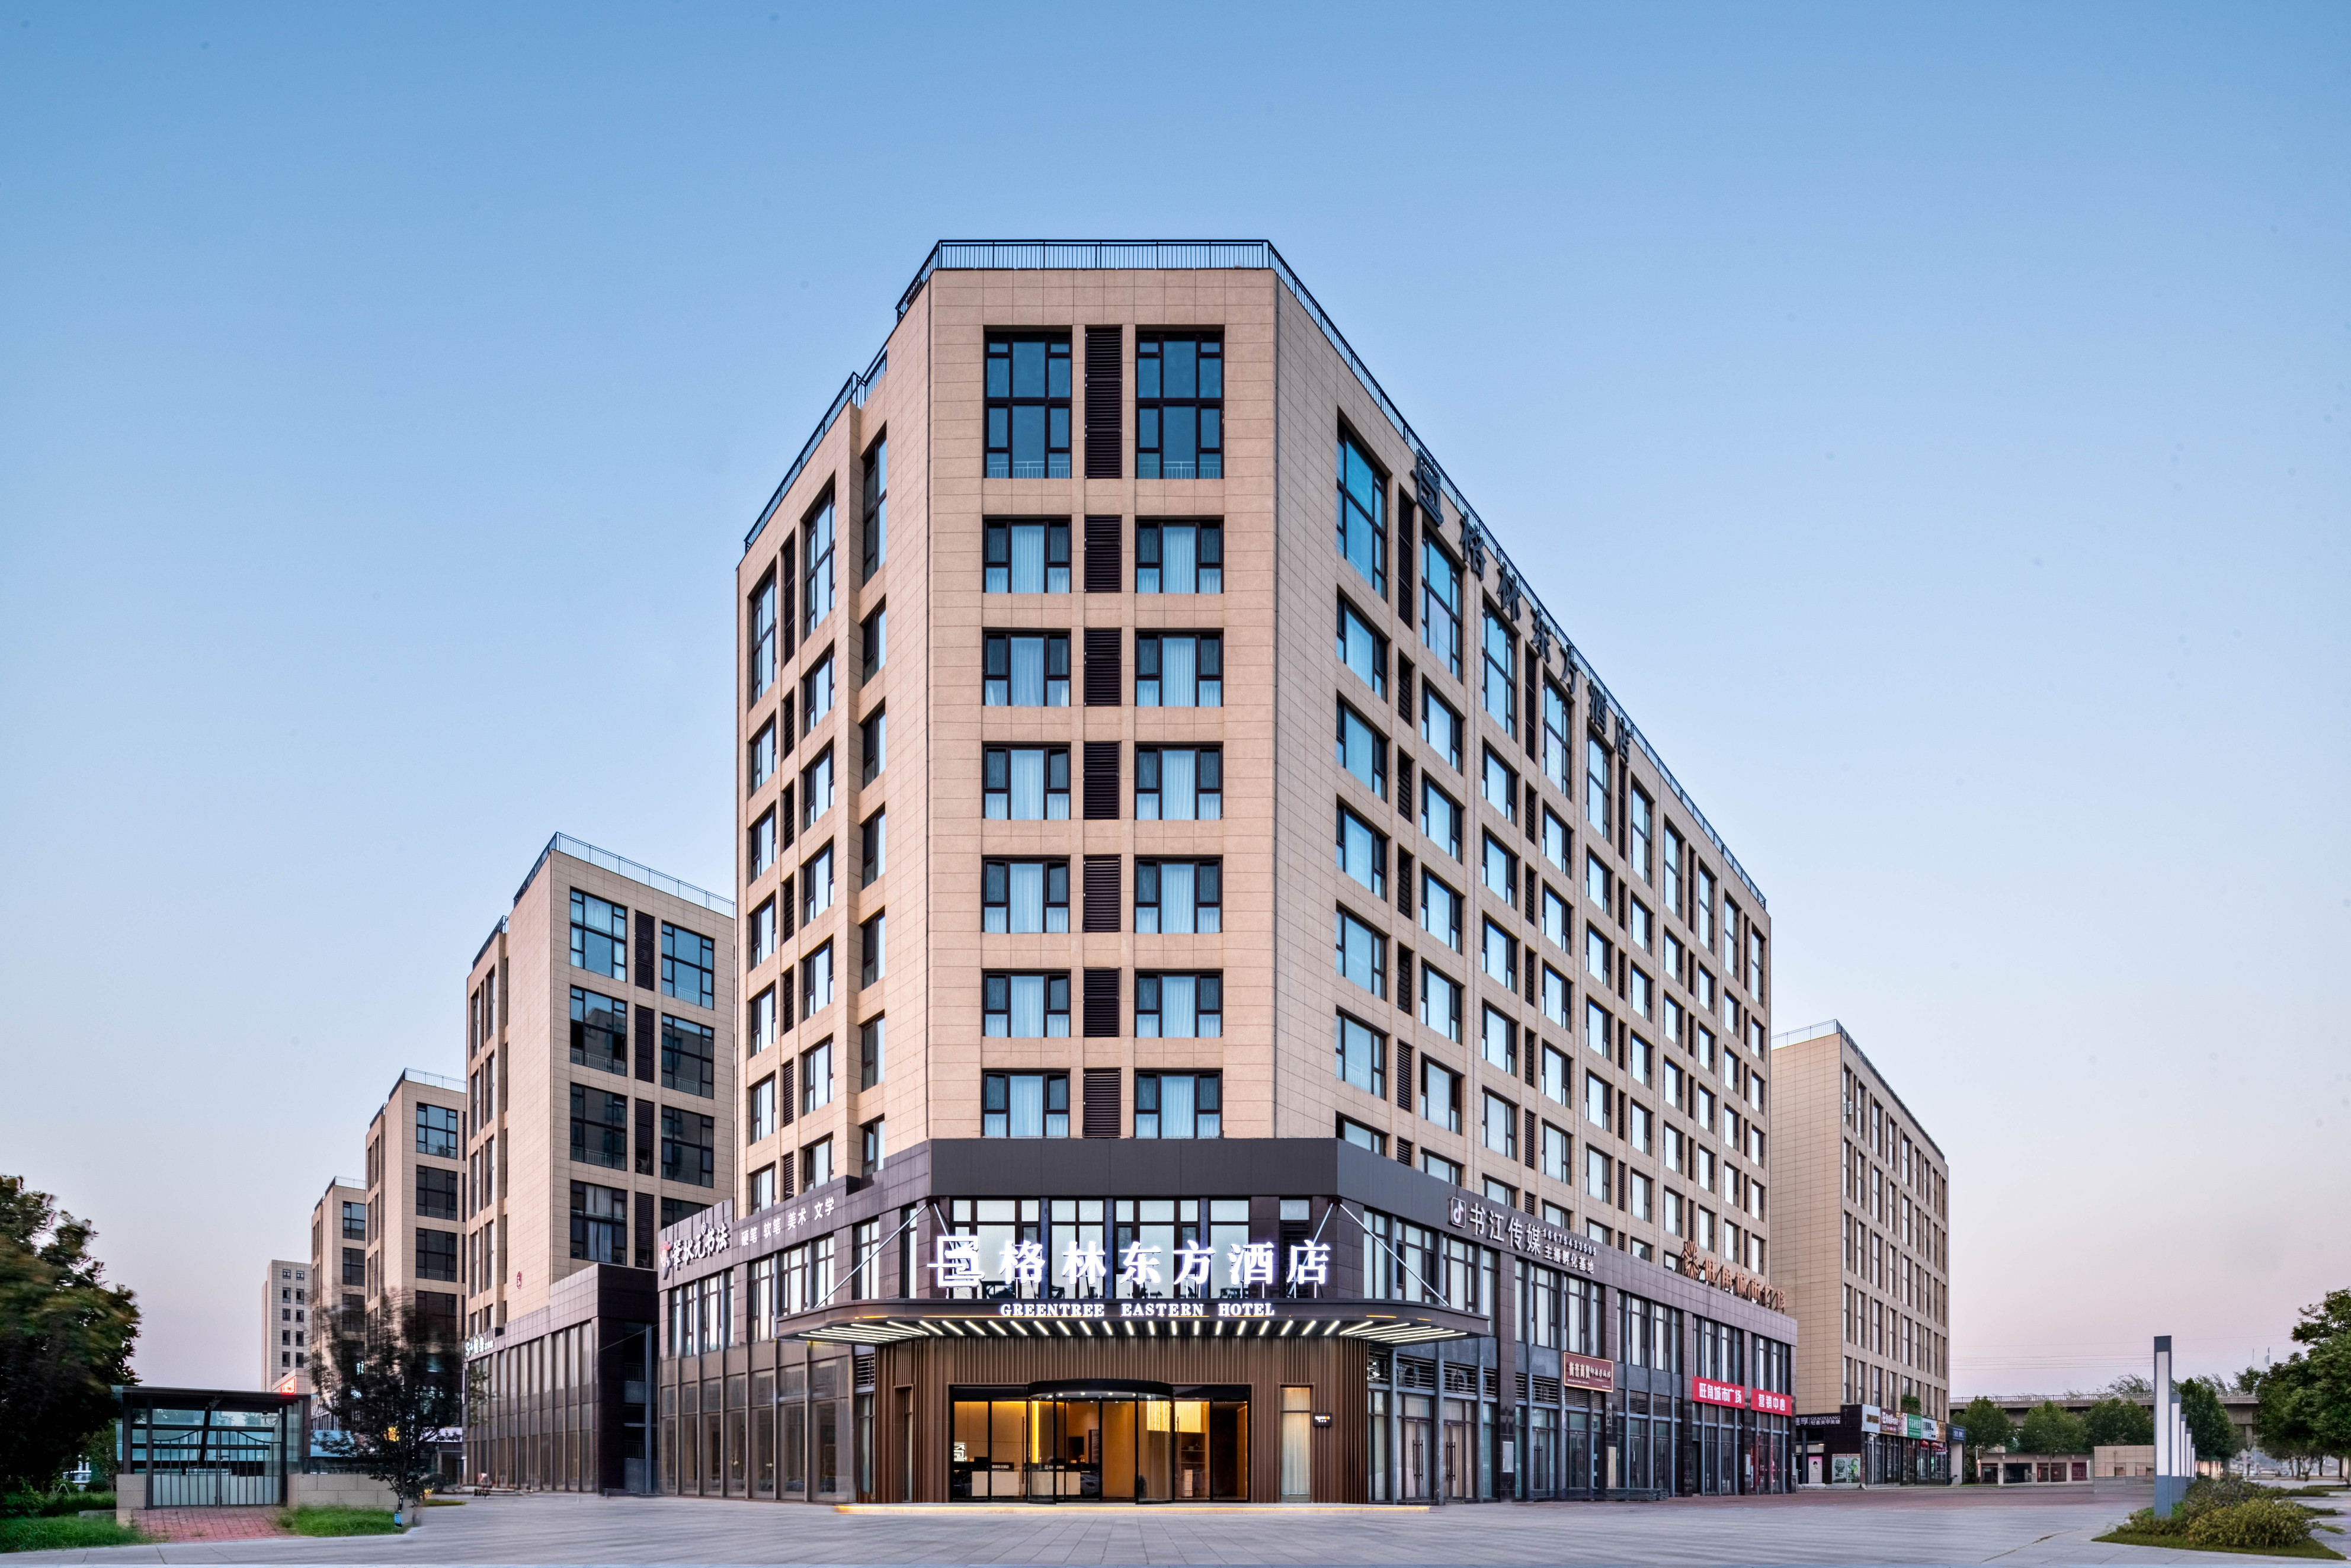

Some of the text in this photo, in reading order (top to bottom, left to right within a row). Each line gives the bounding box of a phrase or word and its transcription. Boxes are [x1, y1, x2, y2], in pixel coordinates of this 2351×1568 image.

[741, 1196, 835, 1247] 硬笔 软笔 美术 文学
[1469, 1203, 1540, 1255] 书江传媒
[1543, 1227, 1597, 1256] 16675433505
[998, 1239, 1331, 1285] 格林东方酒店
[1544, 1244, 1594, 1274] 主播孵化基地
[1000, 1304, 1275, 1317] GREENTREE EASTERN HOTEL
[1699, 1382, 1742, 1404] 旺角城市广场
[1758, 1393, 1786, 1411] 营销中心
